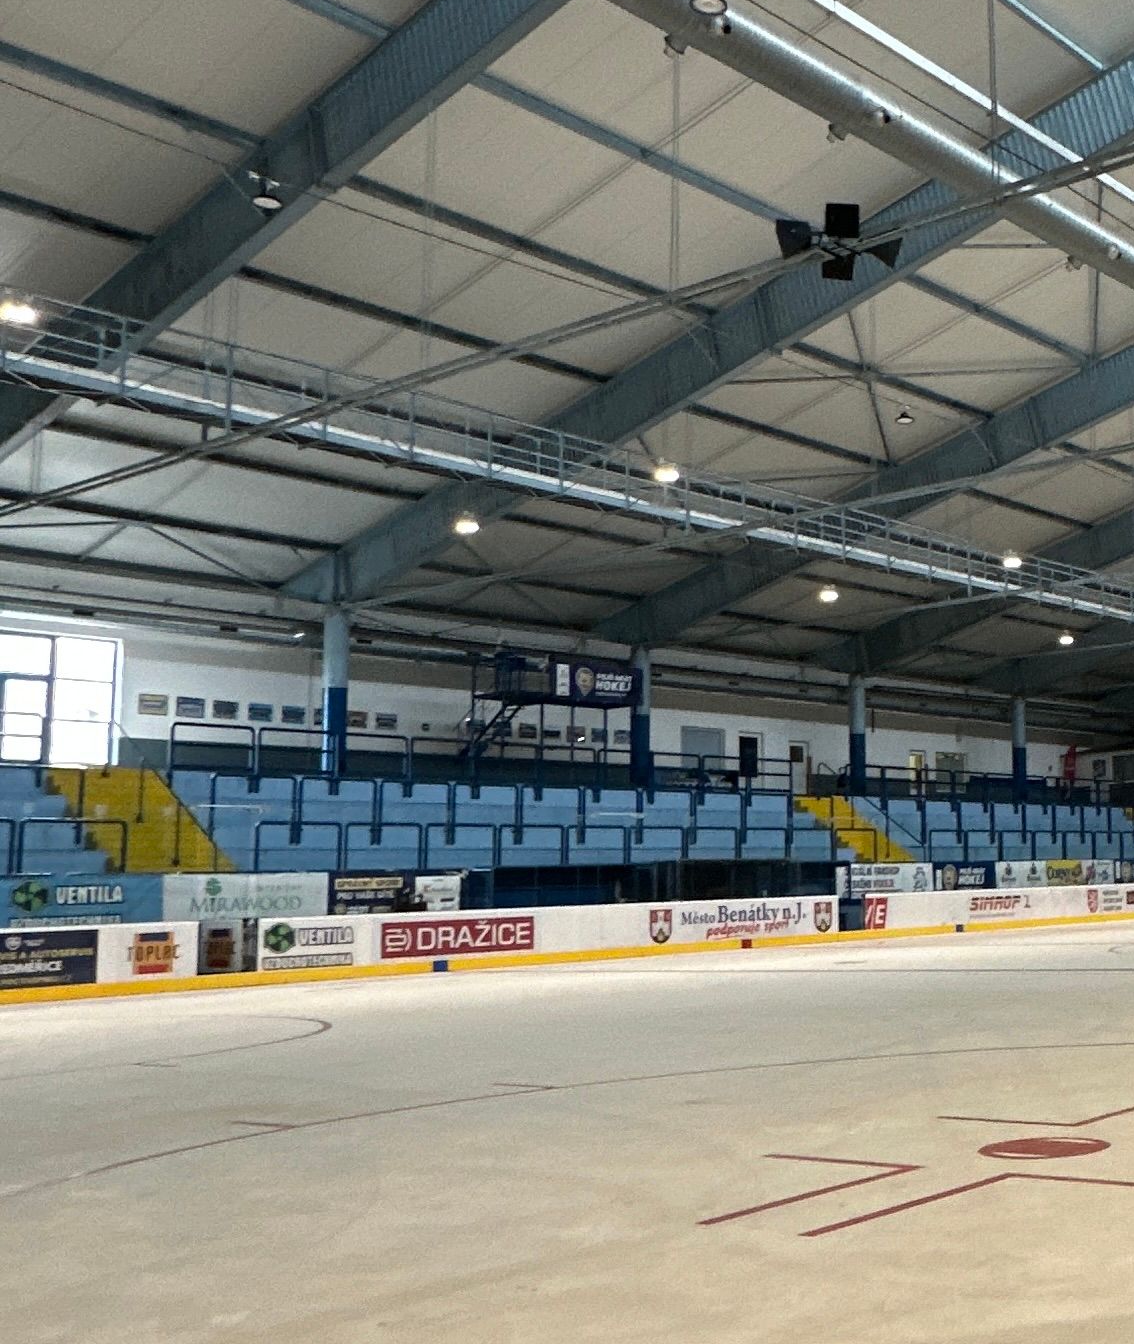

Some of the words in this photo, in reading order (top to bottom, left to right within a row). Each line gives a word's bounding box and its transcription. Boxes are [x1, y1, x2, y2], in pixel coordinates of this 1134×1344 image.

[55, 885, 124, 905] VENTILA
[190, 895, 302, 913] MIRAWOOD
[681, 911, 715, 926] Město
[718, 903, 780, 924] Benátky
[299, 927, 354, 946] VENTILA
[417, 921, 531, 950] DRAŽICE
[706, 923, 760, 940] podporuje
[765, 918, 790, 932] sport
